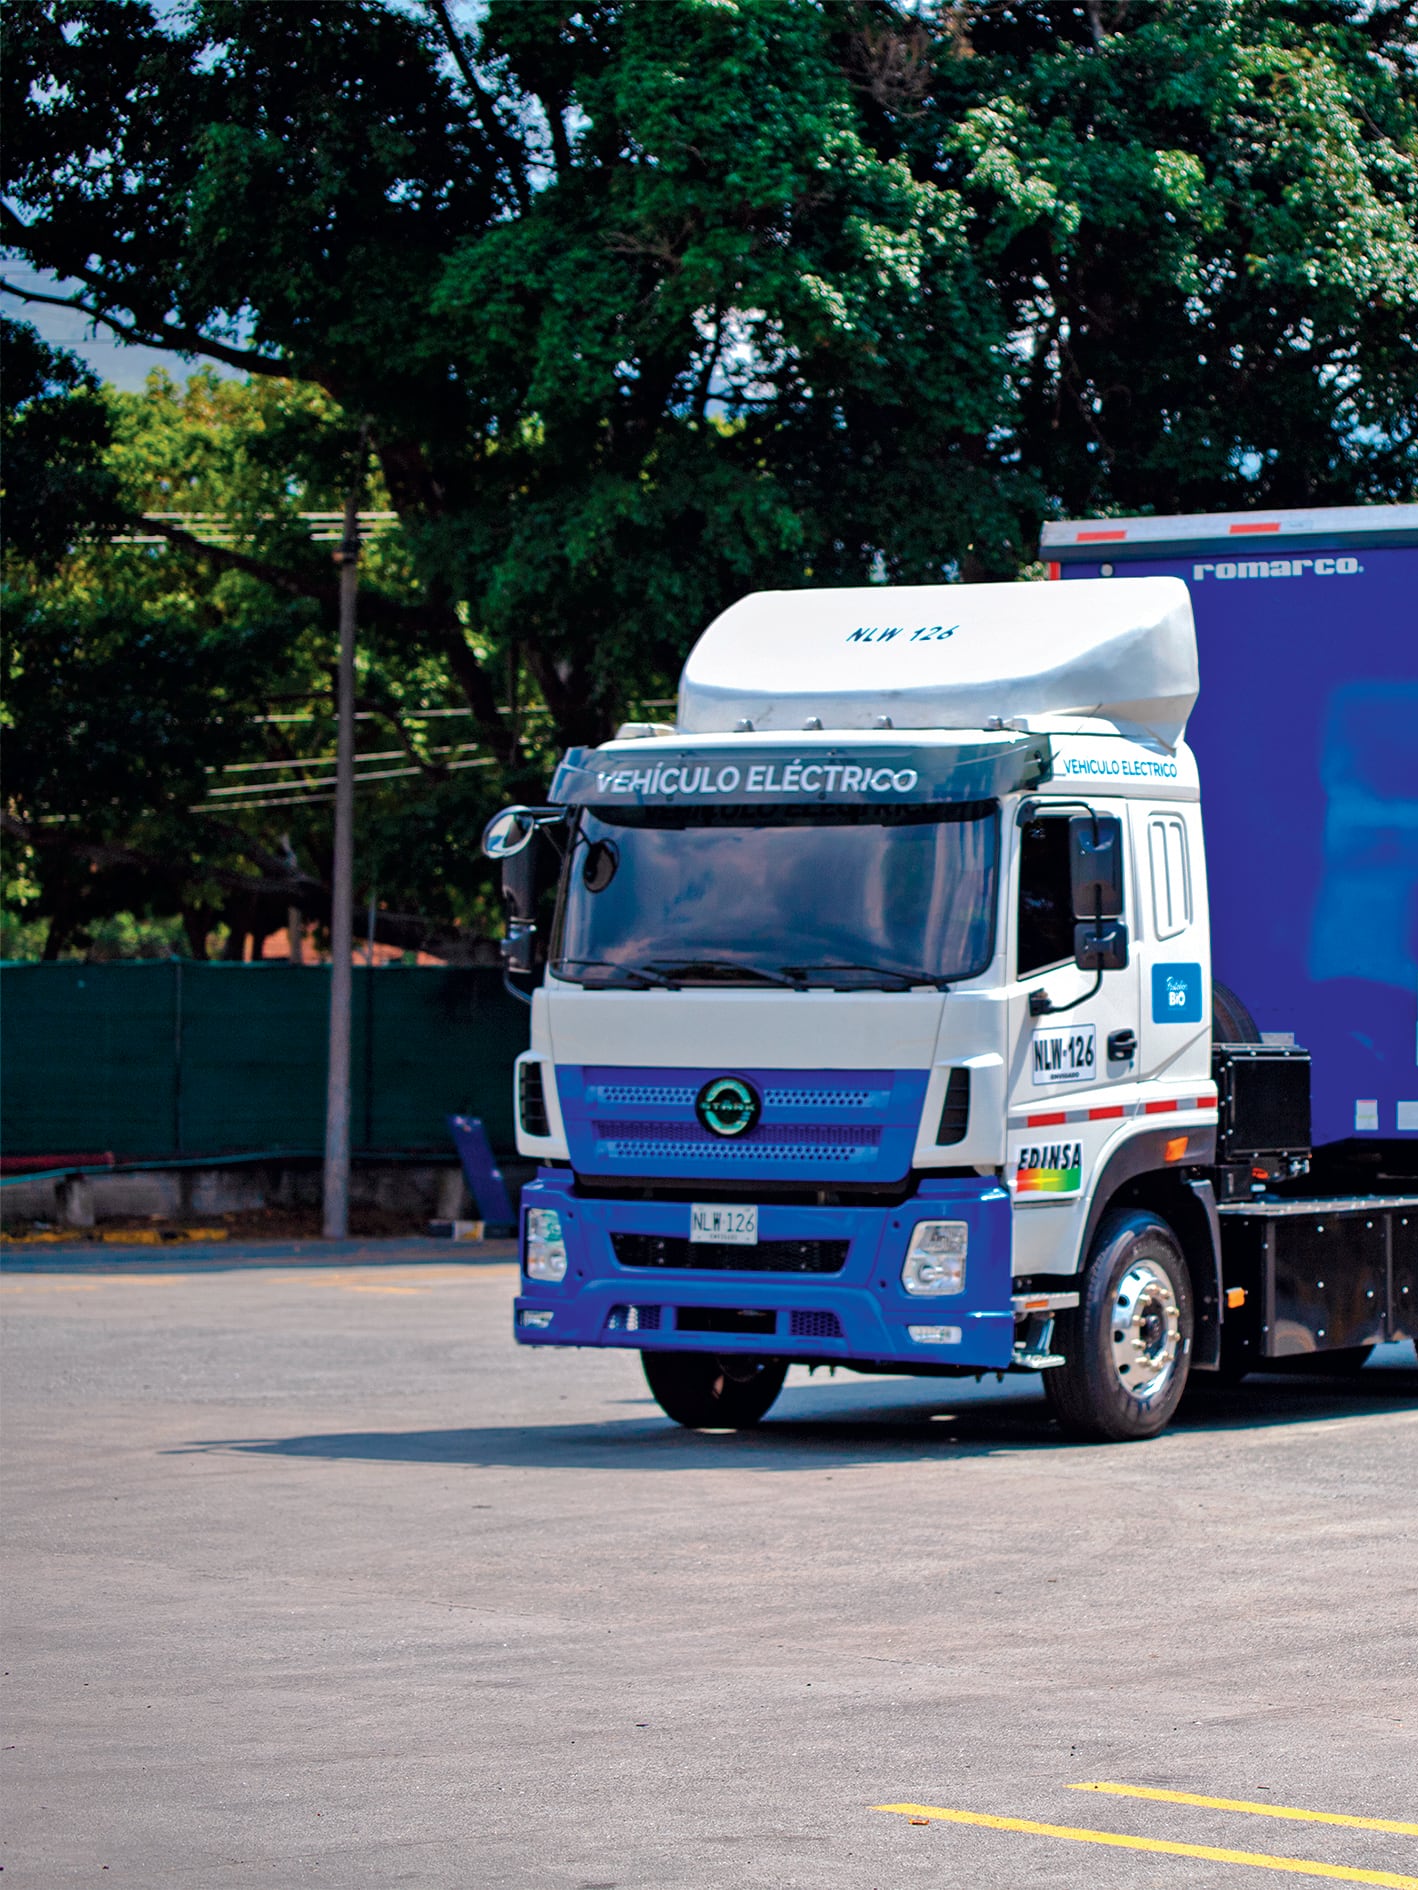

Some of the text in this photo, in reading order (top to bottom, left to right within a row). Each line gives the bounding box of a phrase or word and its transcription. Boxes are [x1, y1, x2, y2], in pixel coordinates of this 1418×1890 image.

[845, 625, 960, 642] NLW 126
[597, 758, 918, 795] VEHÍCULO ELÉCTRICO
[1017, 1143, 1081, 1170] EDINSA
